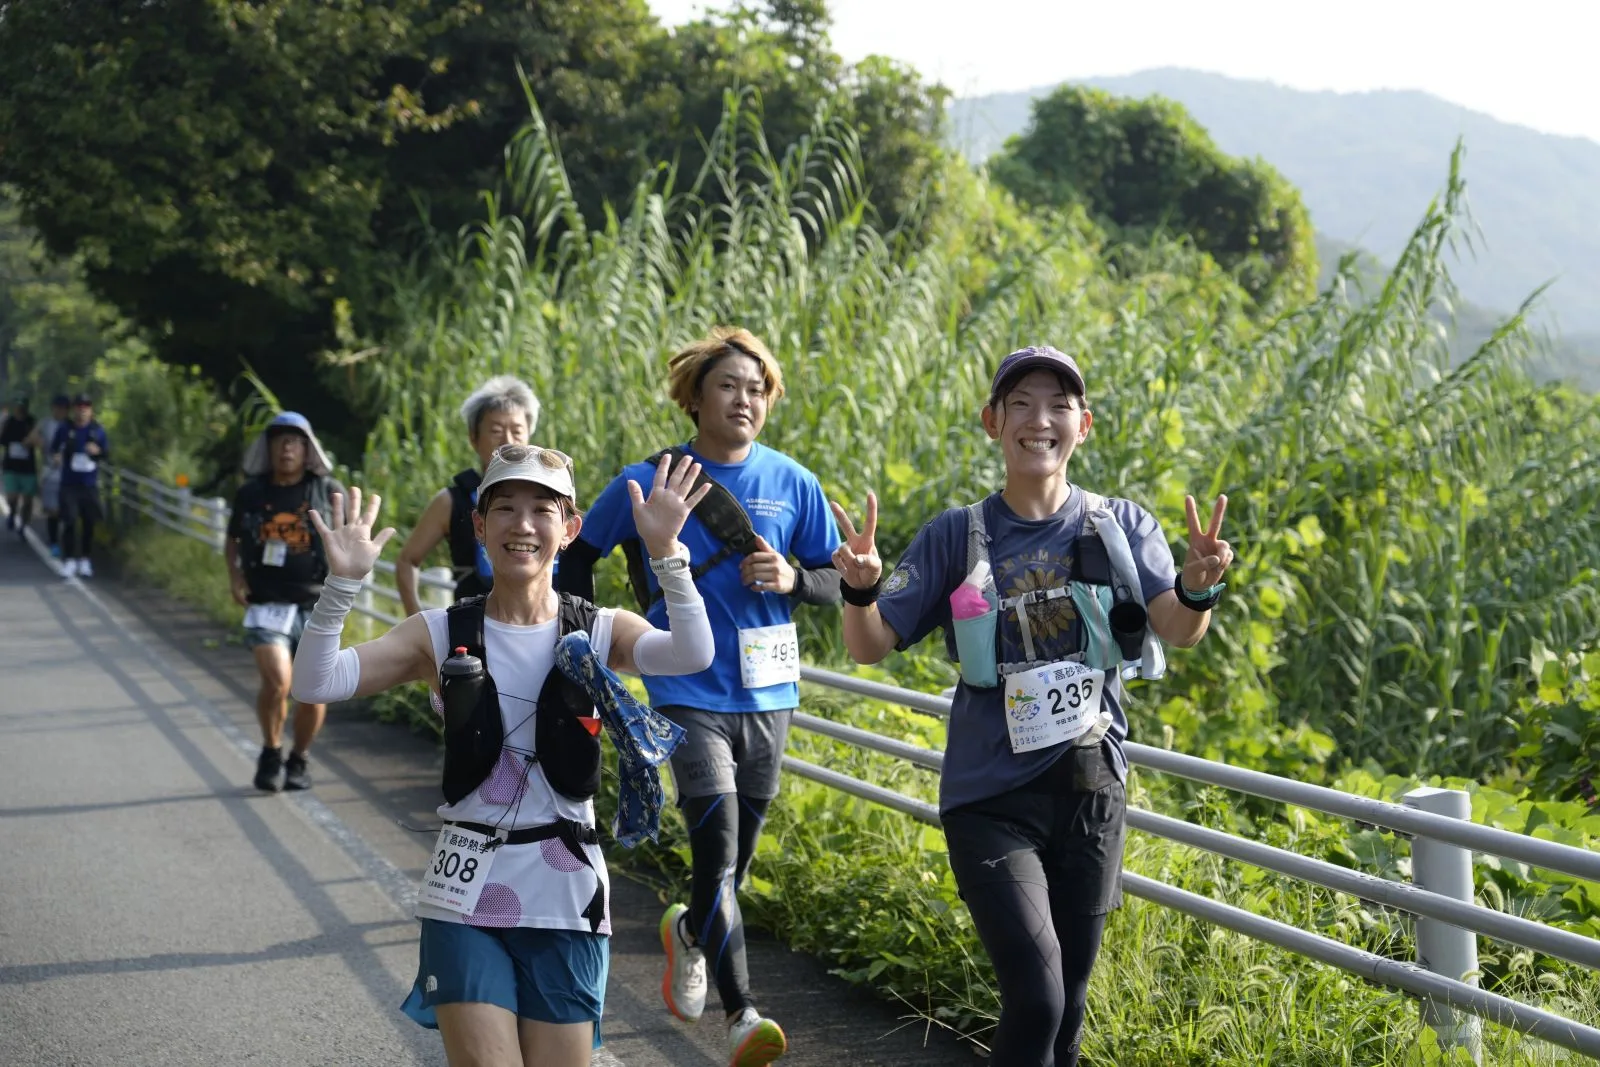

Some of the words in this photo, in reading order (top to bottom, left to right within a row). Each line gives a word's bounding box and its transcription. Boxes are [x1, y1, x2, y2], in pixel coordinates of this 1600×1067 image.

[771, 641, 796, 662] 495
[1047, 678, 1094, 716] 236
[434, 849, 479, 883] 308
